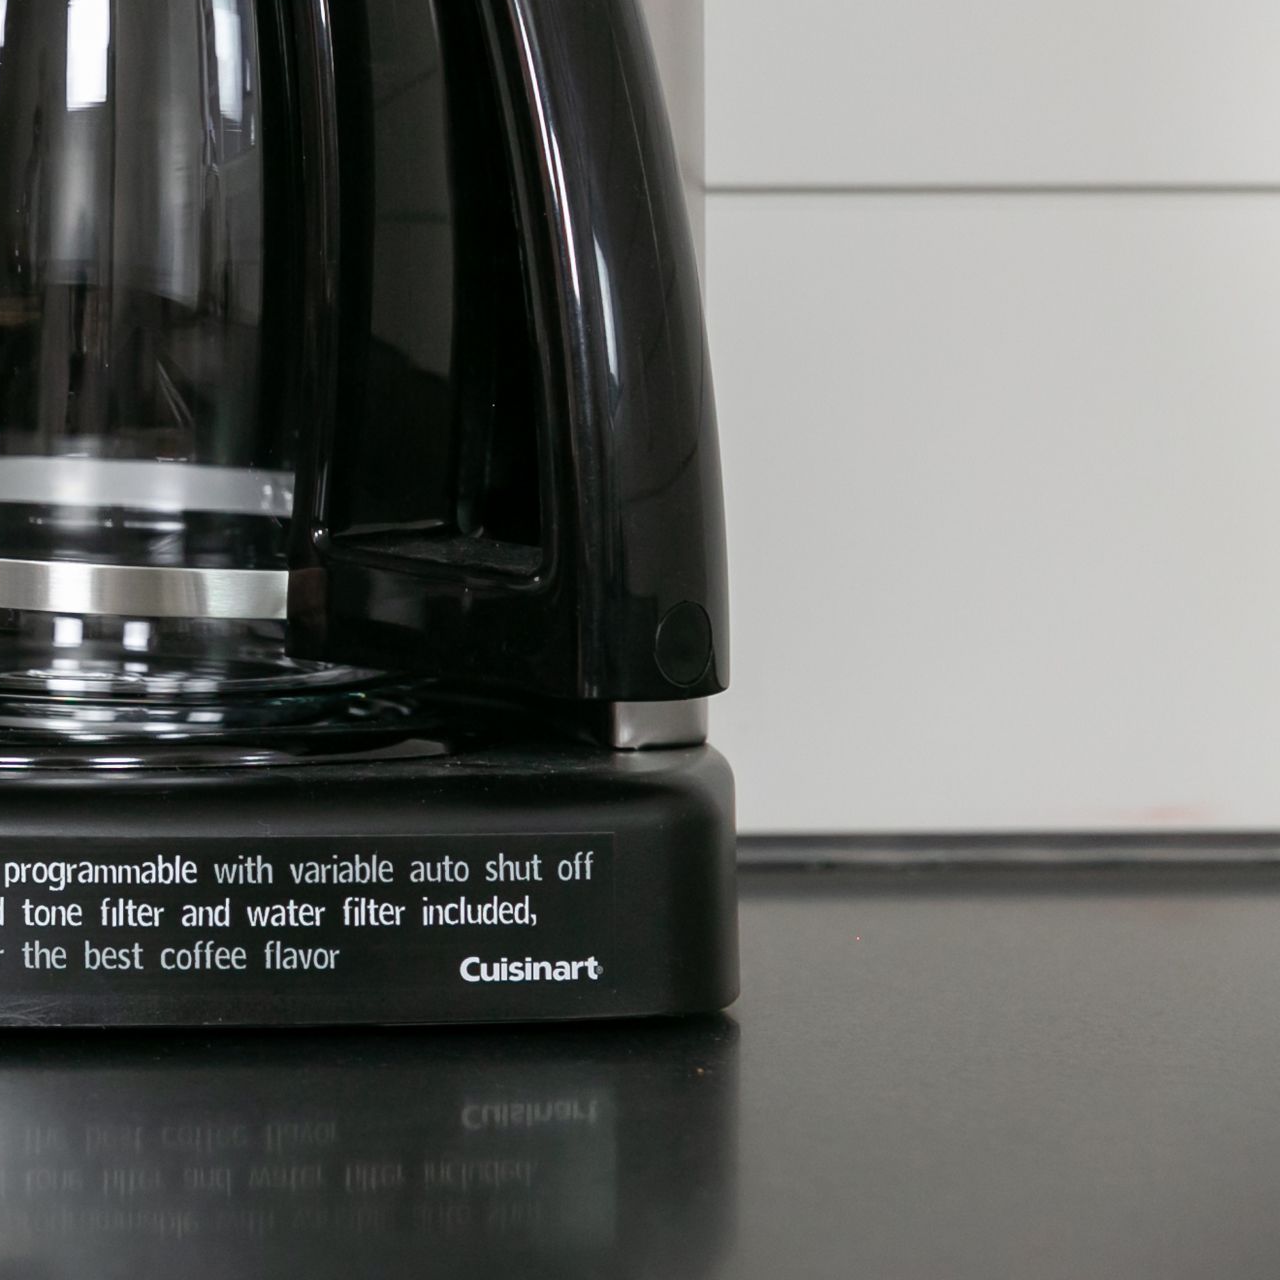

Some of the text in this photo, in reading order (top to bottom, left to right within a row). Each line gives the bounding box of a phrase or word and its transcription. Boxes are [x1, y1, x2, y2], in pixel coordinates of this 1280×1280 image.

[3, 853, 199, 891] programmable
[212, 853, 274, 886] with
[288, 853, 395, 885] variable
[408, 854, 471, 884] auto
[484, 851, 544, 883] shut
[556, 850, 595, 882] off
[20, 897, 84, 928] tone
[99, 896, 166, 928] filter
[180, 896, 231, 928] and
[245, 898, 327, 928] water
[341, 895, 407, 928] filter
[421, 894, 538, 927] included,
[20, 939, 68, 970] the
[83, 939, 145, 971] best
[159, 939, 248, 971] coffee
[263, 939, 341, 971] flavor
[458, 955, 601, 983] Cuisinart
